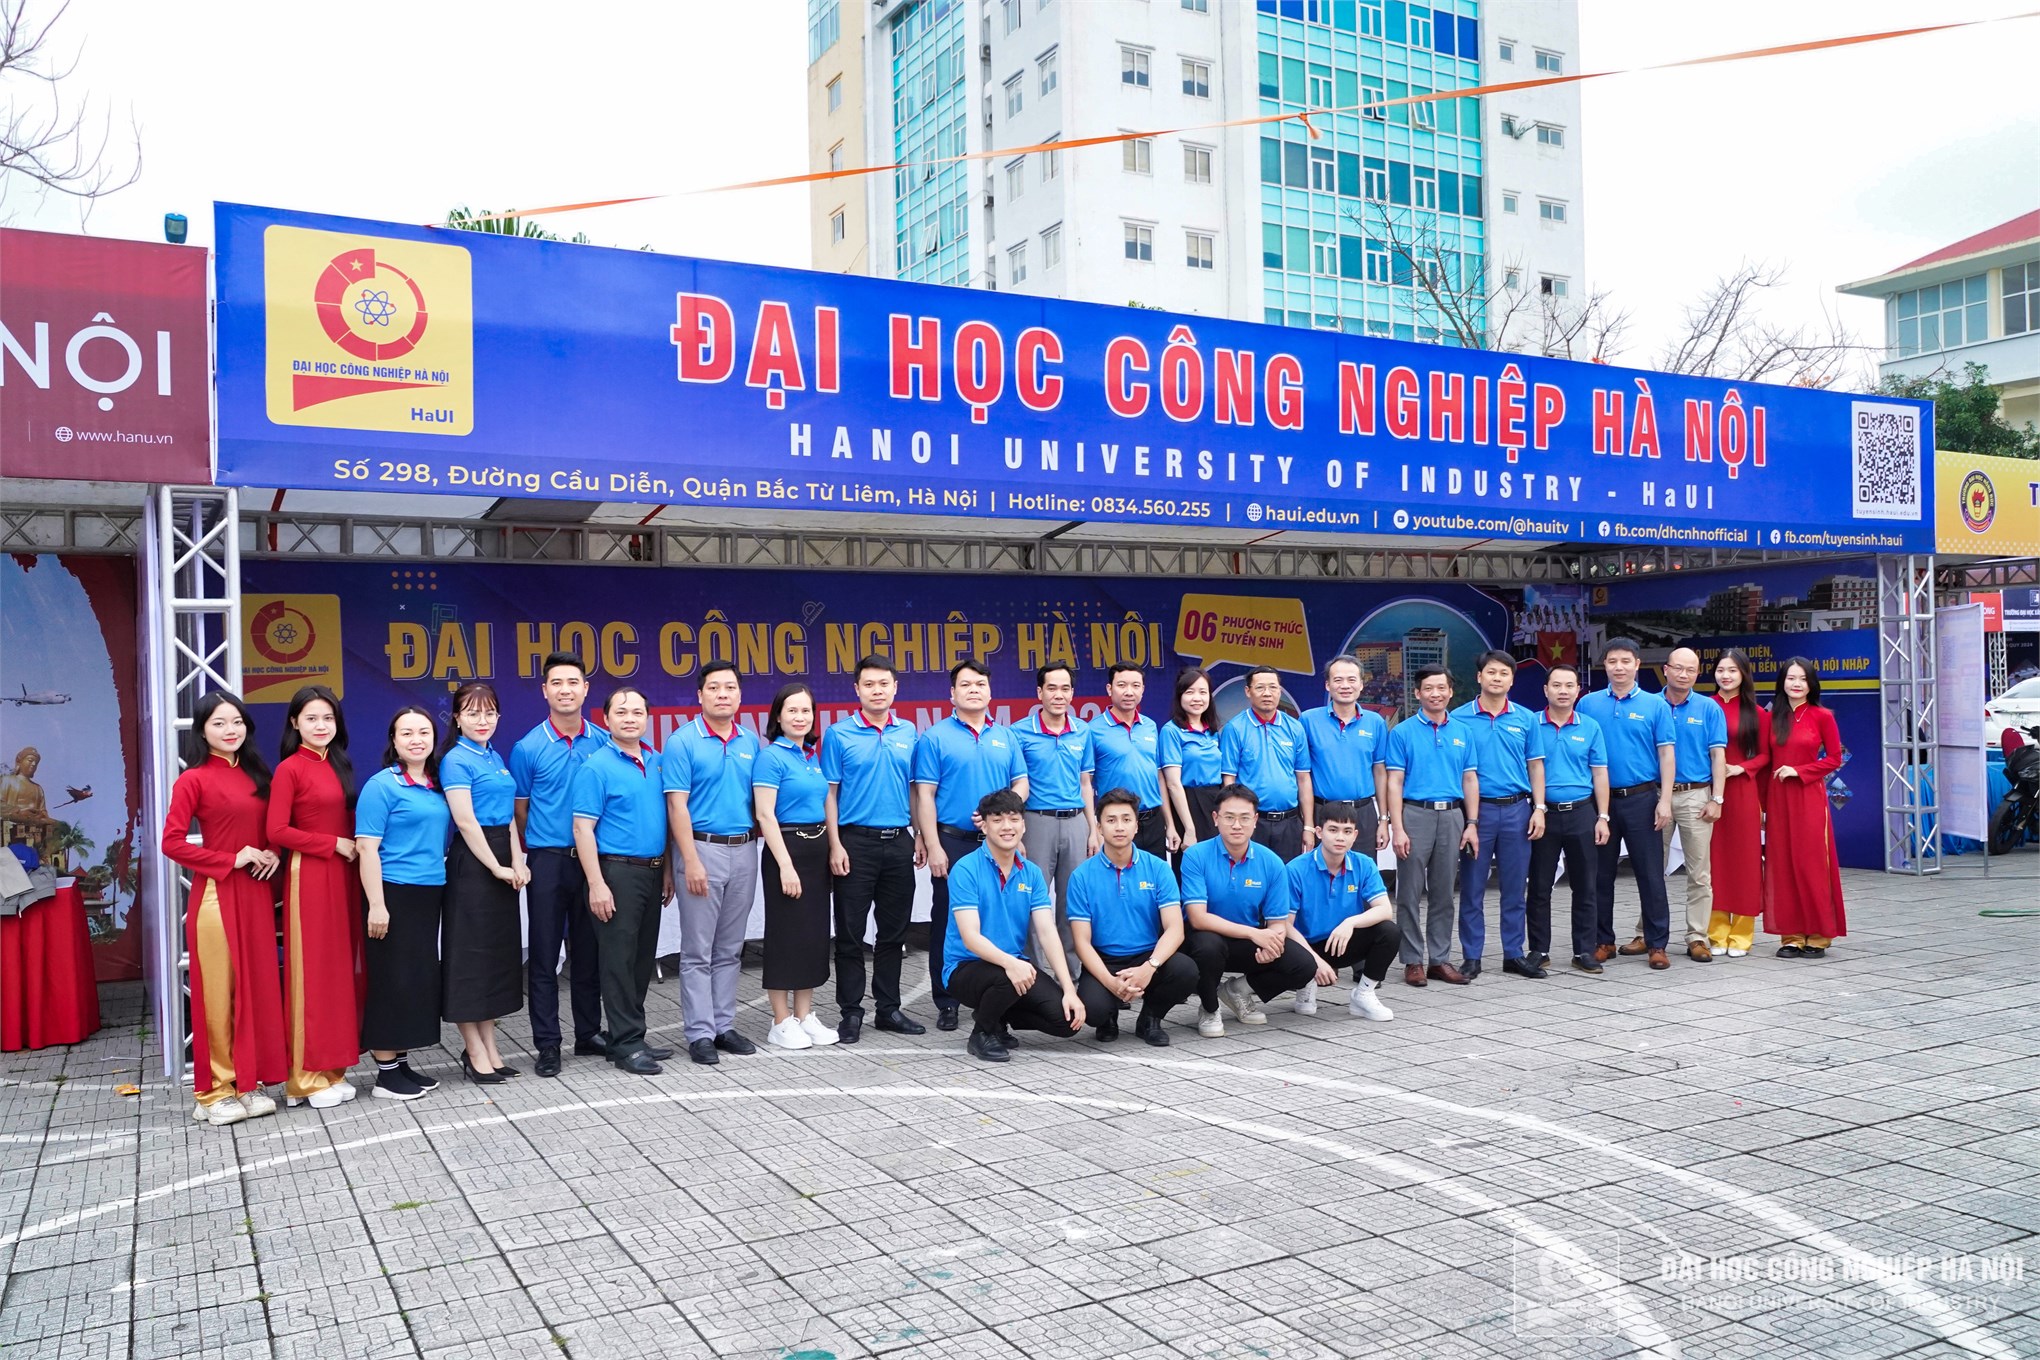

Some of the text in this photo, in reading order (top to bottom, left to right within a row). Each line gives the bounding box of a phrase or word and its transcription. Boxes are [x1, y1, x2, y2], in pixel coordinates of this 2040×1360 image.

[0, 312, 171, 412] NỘI
[292, 360, 450, 385] ĐẠI HỌC CÔNG NGHIỆP HÀ NỘI
[670, 291, 1767, 480] ĐẠI HỌC CÔNG NGHIỆP HÀ NỘI
[411, 407, 454, 424] HaUI
[76, 430, 173, 445] www.hanu.vn
[790, 422, 960, 465] HANOI
[1004, 437, 1294, 486] UNIVERSITY
[1326, 459, 1369, 489] OF
[1401, 464, 1582, 502] INDUSTRY
[1642, 481, 1714, 511] HaUI
[333, 458, 978, 511] Số 298, Đường Cầu Diễn, Quận Bắc Từ Liêm, Hà Nội
[1008, 492, 1212, 518] Hotline: 0834.560.255
[1266, 505, 1360, 525] haui.edu.vn
[1412, 514, 1570, 536] youtube.com/@hauitv
[1614, 522, 1748, 544] fb.com/dhcnhnofficial
[1784, 531, 1903, 548] fb.com/tuyensinh.haui
[1183, 609, 1218, 643] 06
[384, 621, 495, 693] ĐẠI
[659, 609, 809, 679] CÔNG
[1017, 611, 1080, 671] HÀ
[1221, 630, 1285, 650] TUYỂN SINH
[1822, 656, 1839, 674] HỘI
[1842, 655, 1871, 673] NHẬP
